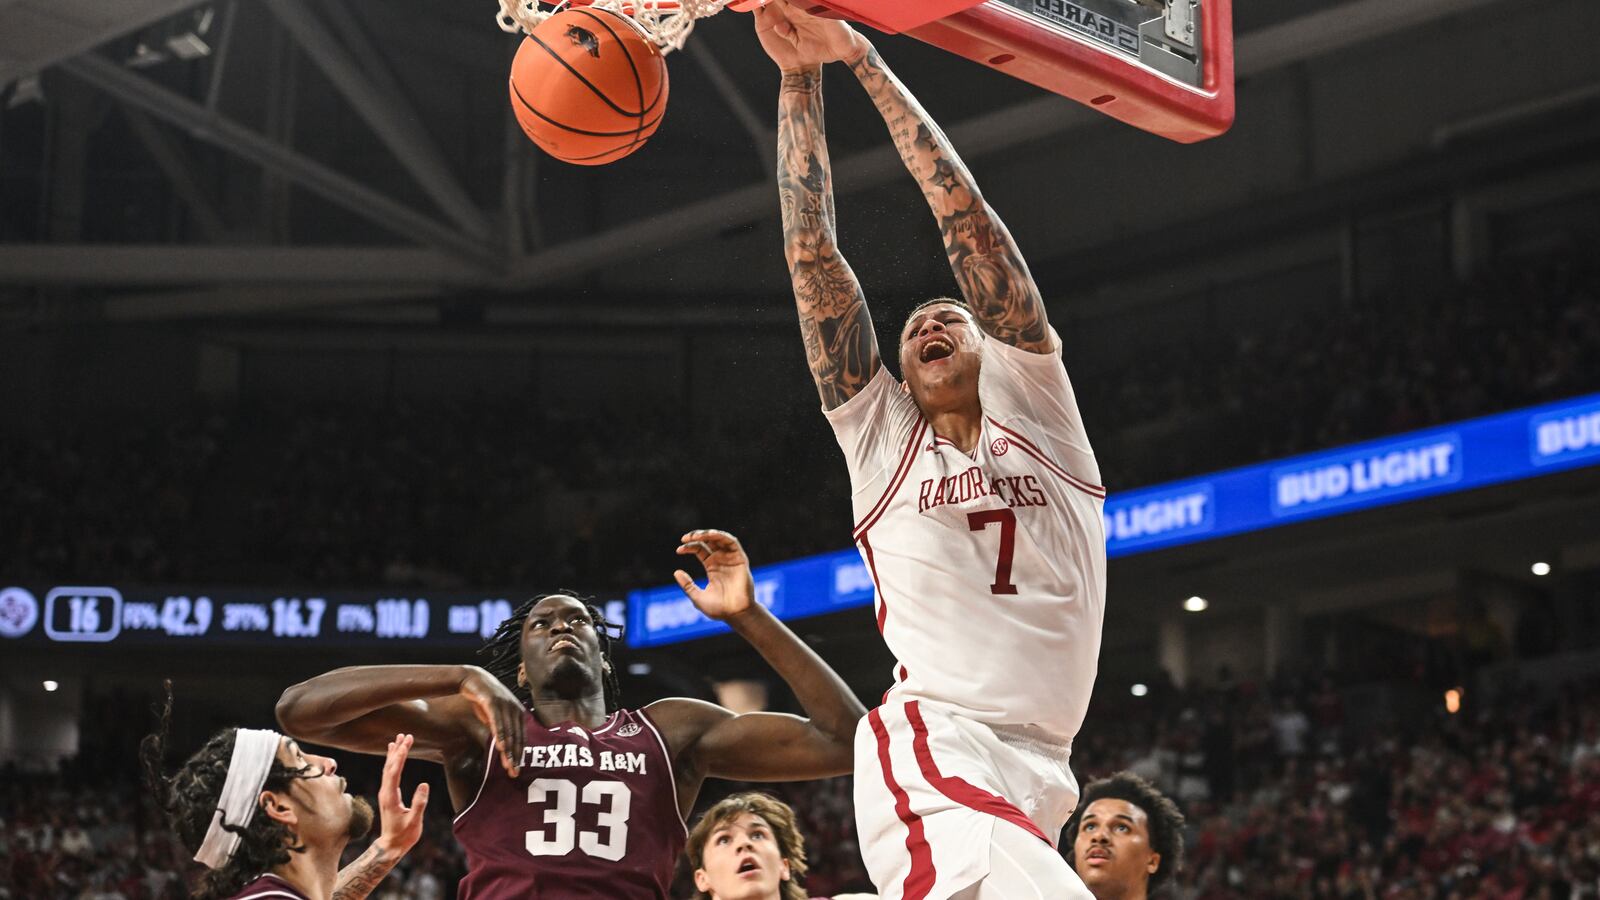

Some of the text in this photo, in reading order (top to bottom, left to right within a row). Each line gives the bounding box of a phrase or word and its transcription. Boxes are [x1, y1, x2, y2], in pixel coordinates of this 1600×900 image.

[1278, 443, 1454, 506] BUD LIGHT
[1115, 492, 1207, 539] LIGHT
[967, 508, 1018, 595] 7
[69, 596, 99, 633] 16
[161, 596, 213, 636] 42.9
[272, 597, 326, 637] 16.7
[600, 751, 647, 775] A&M
[525, 778, 632, 862] 33
